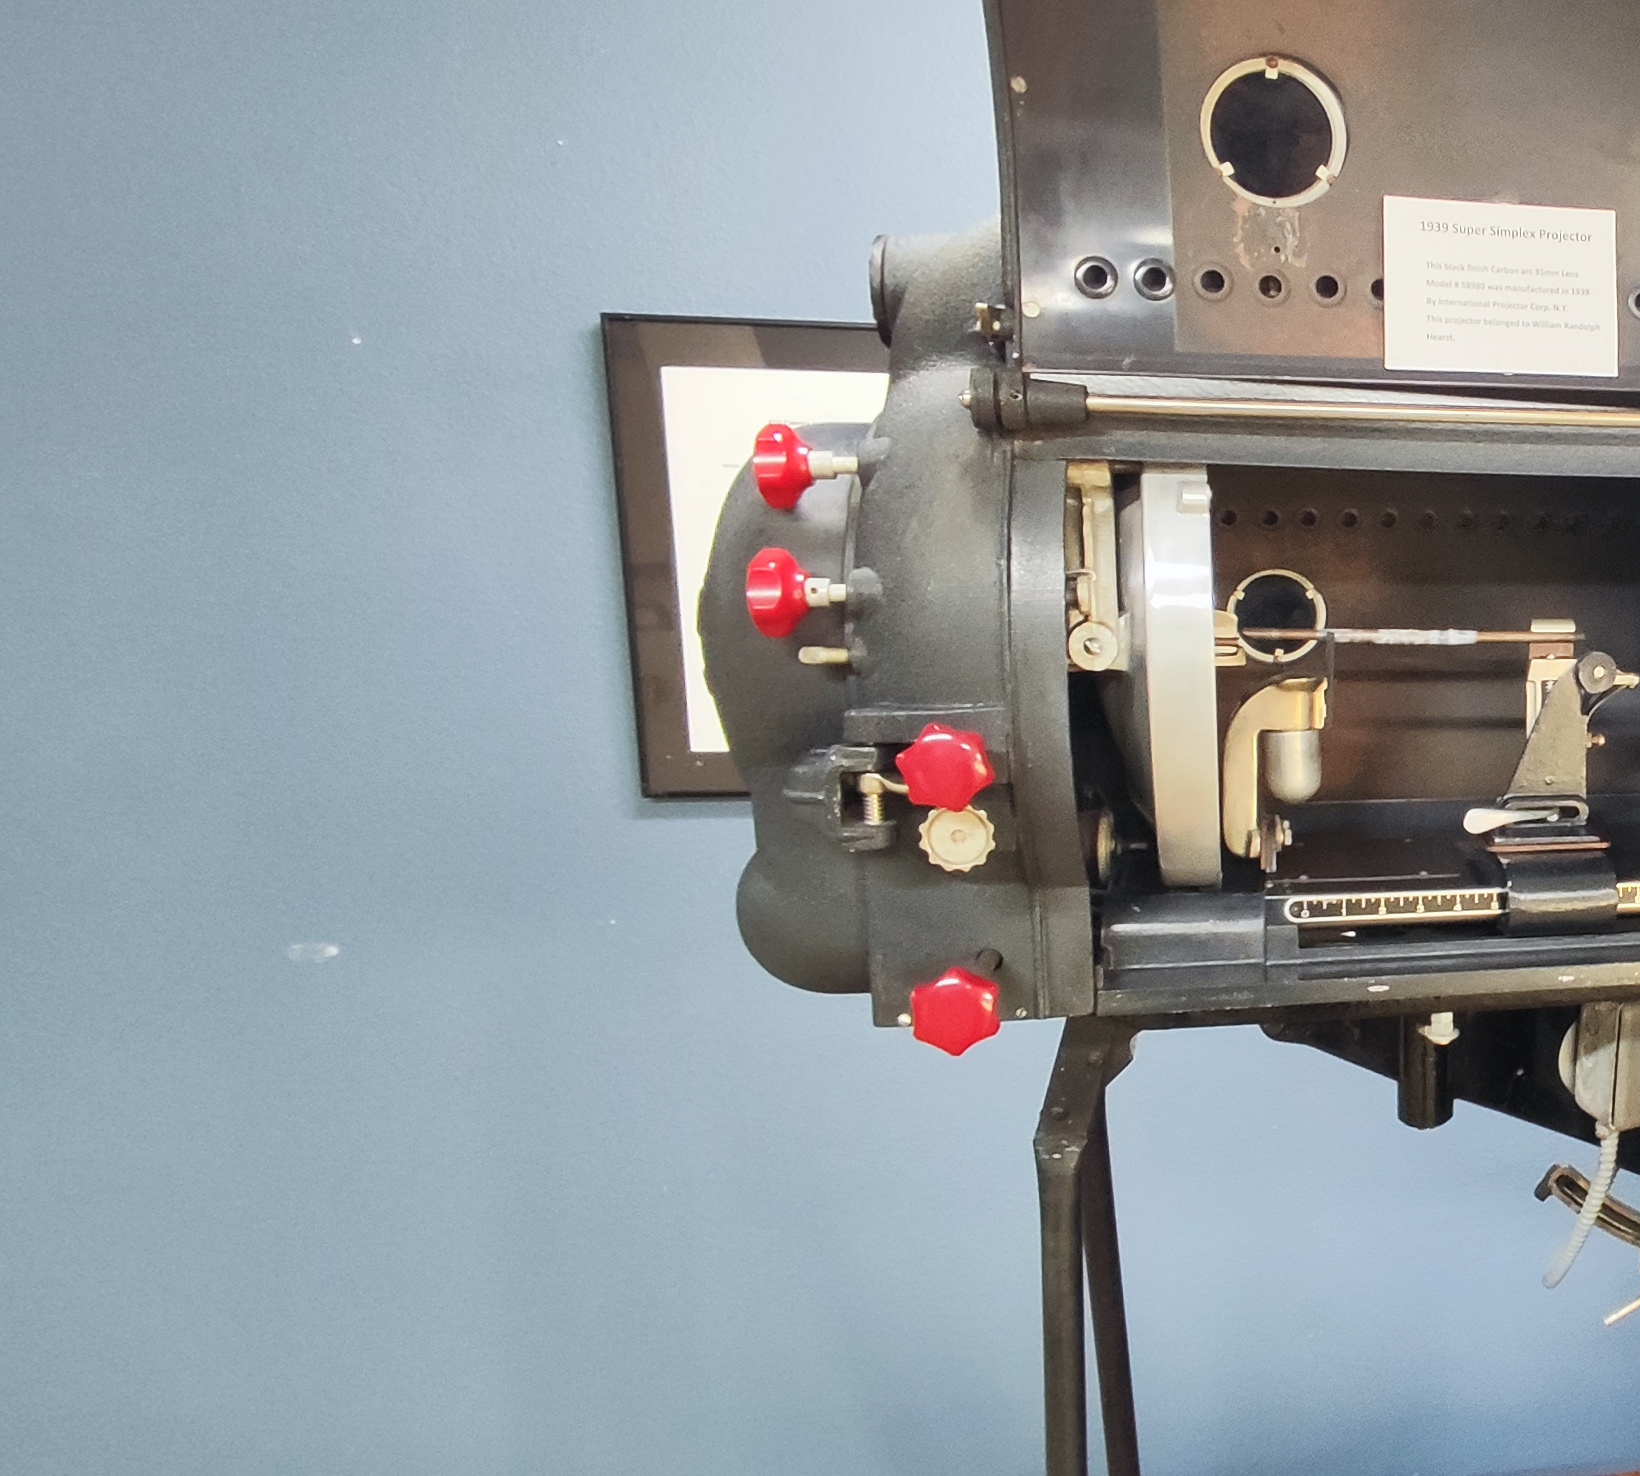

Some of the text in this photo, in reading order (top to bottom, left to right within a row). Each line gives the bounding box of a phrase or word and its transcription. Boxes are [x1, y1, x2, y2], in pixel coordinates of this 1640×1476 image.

[1420, 221, 1592, 243] 1939 Super Simplex Projector
[1425, 261, 1580, 279] This black finish Carbon arc 35mm Lens
[1426, 279, 1452, 289] Model
[1487, 284, 1503, 292] was
[1504, 284, 1560, 295] manufactured
[1561, 286, 1570, 295] in
[1571, 287, 1590, 297] 1939
[1426, 296, 1436, 307] By
[1438, 297, 1491, 308] International
[1492, 299, 1528, 311] Projector
[1530, 302, 1551, 313] Corp.
[1426, 314, 1601, 333] This projector belonged to William Randolph
